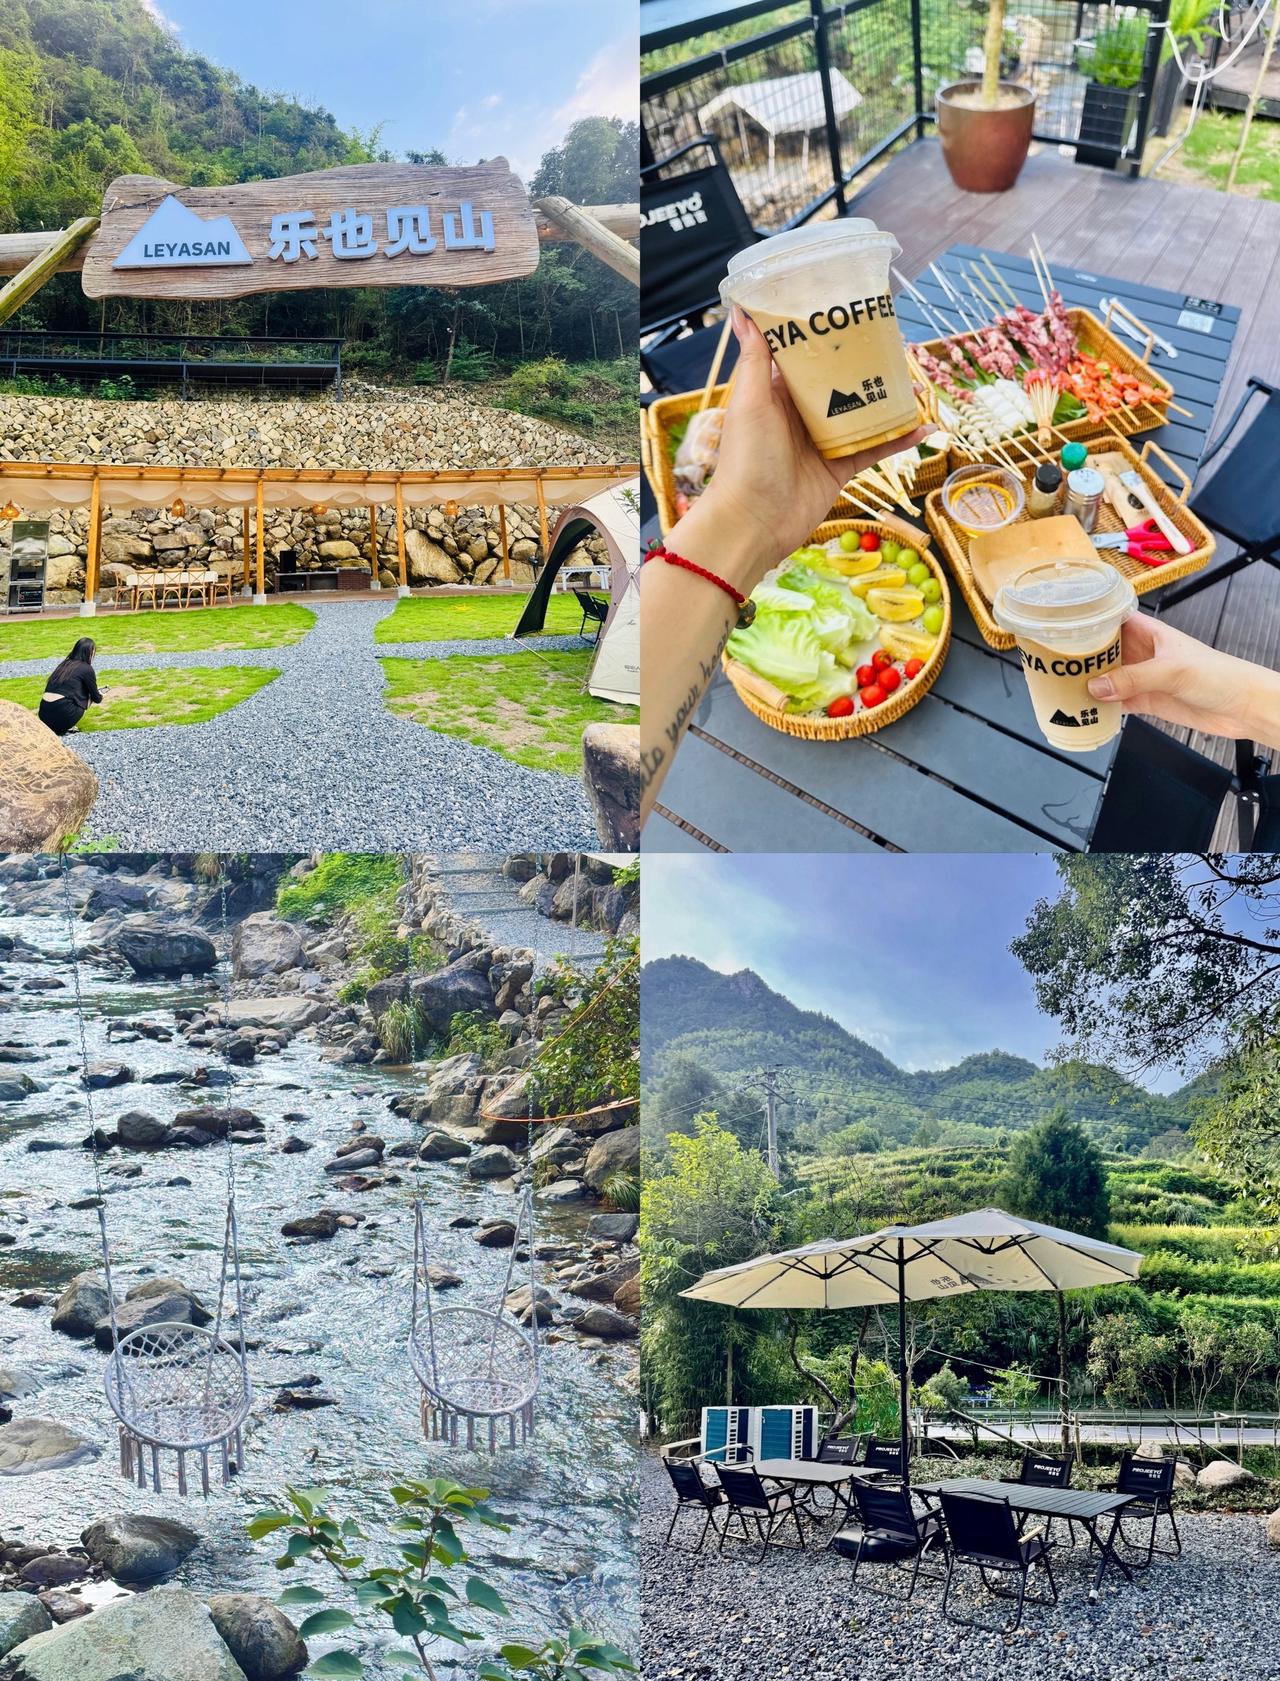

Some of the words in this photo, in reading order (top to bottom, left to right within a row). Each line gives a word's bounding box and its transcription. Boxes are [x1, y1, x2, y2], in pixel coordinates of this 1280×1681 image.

[266, 202, 497, 264] 乐也见山
[143, 241, 231, 258] LEYASAN
[808, 294, 895, 336] COFFEE
[861, 375, 885, 392] 乐也
[865, 387, 888, 405] 见山
[830, 400, 862, 415] LEYASAN
[1051, 639, 1120, 676] COFFEE
